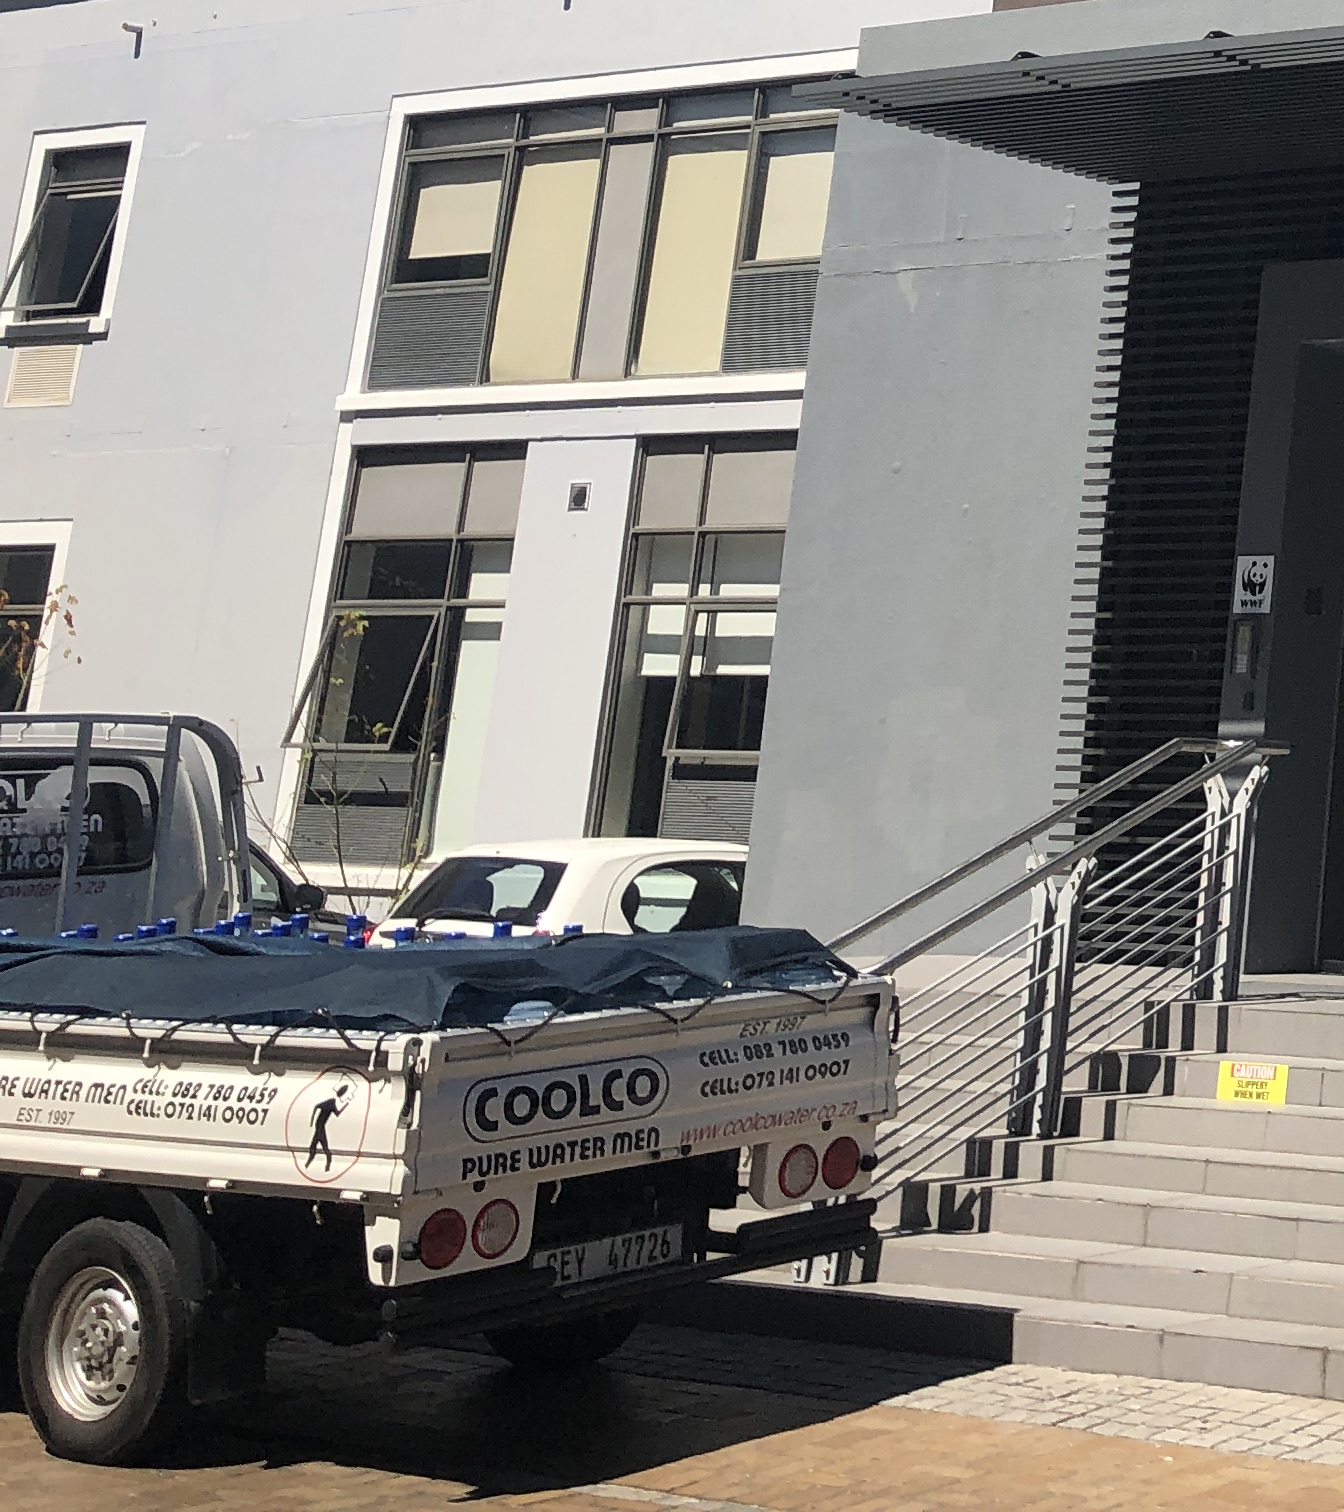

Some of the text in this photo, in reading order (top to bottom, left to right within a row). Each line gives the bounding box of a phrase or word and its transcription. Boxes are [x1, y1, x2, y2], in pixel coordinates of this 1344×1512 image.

[1240, 598, 1265, 608] WWF
[739, 1016, 807, 1039] EST. 1997
[700, 1032, 850, 1067] CELL: 082 780 0459
[701, 1077, 740, 1097] CELL:
[742, 1070, 775, 1091] 072
[804, 1059, 851, 1081] 0907
[1233, 1064, 1275, 1079] CAUTION
[1237, 1080, 1268, 1090] SLIPPERY
[21, 1077, 81, 1102] WATER
[84, 1082, 127, 1106] MEN
[132, 1077, 278, 1105] CELL: 082 780 0459
[475, 1068, 660, 1132] COOLCO
[1234, 1090, 1270, 1100] WHEN WET
[16, 1107, 76, 1126] EST. 1997
[126, 1099, 161, 1119] CELL:
[164, 1101, 195, 1121] 072
[221, 1105, 270, 1126] 0907
[462, 1126, 660, 1180] PURE WATER MEN
[608, 1229, 671, 1270] 47726
